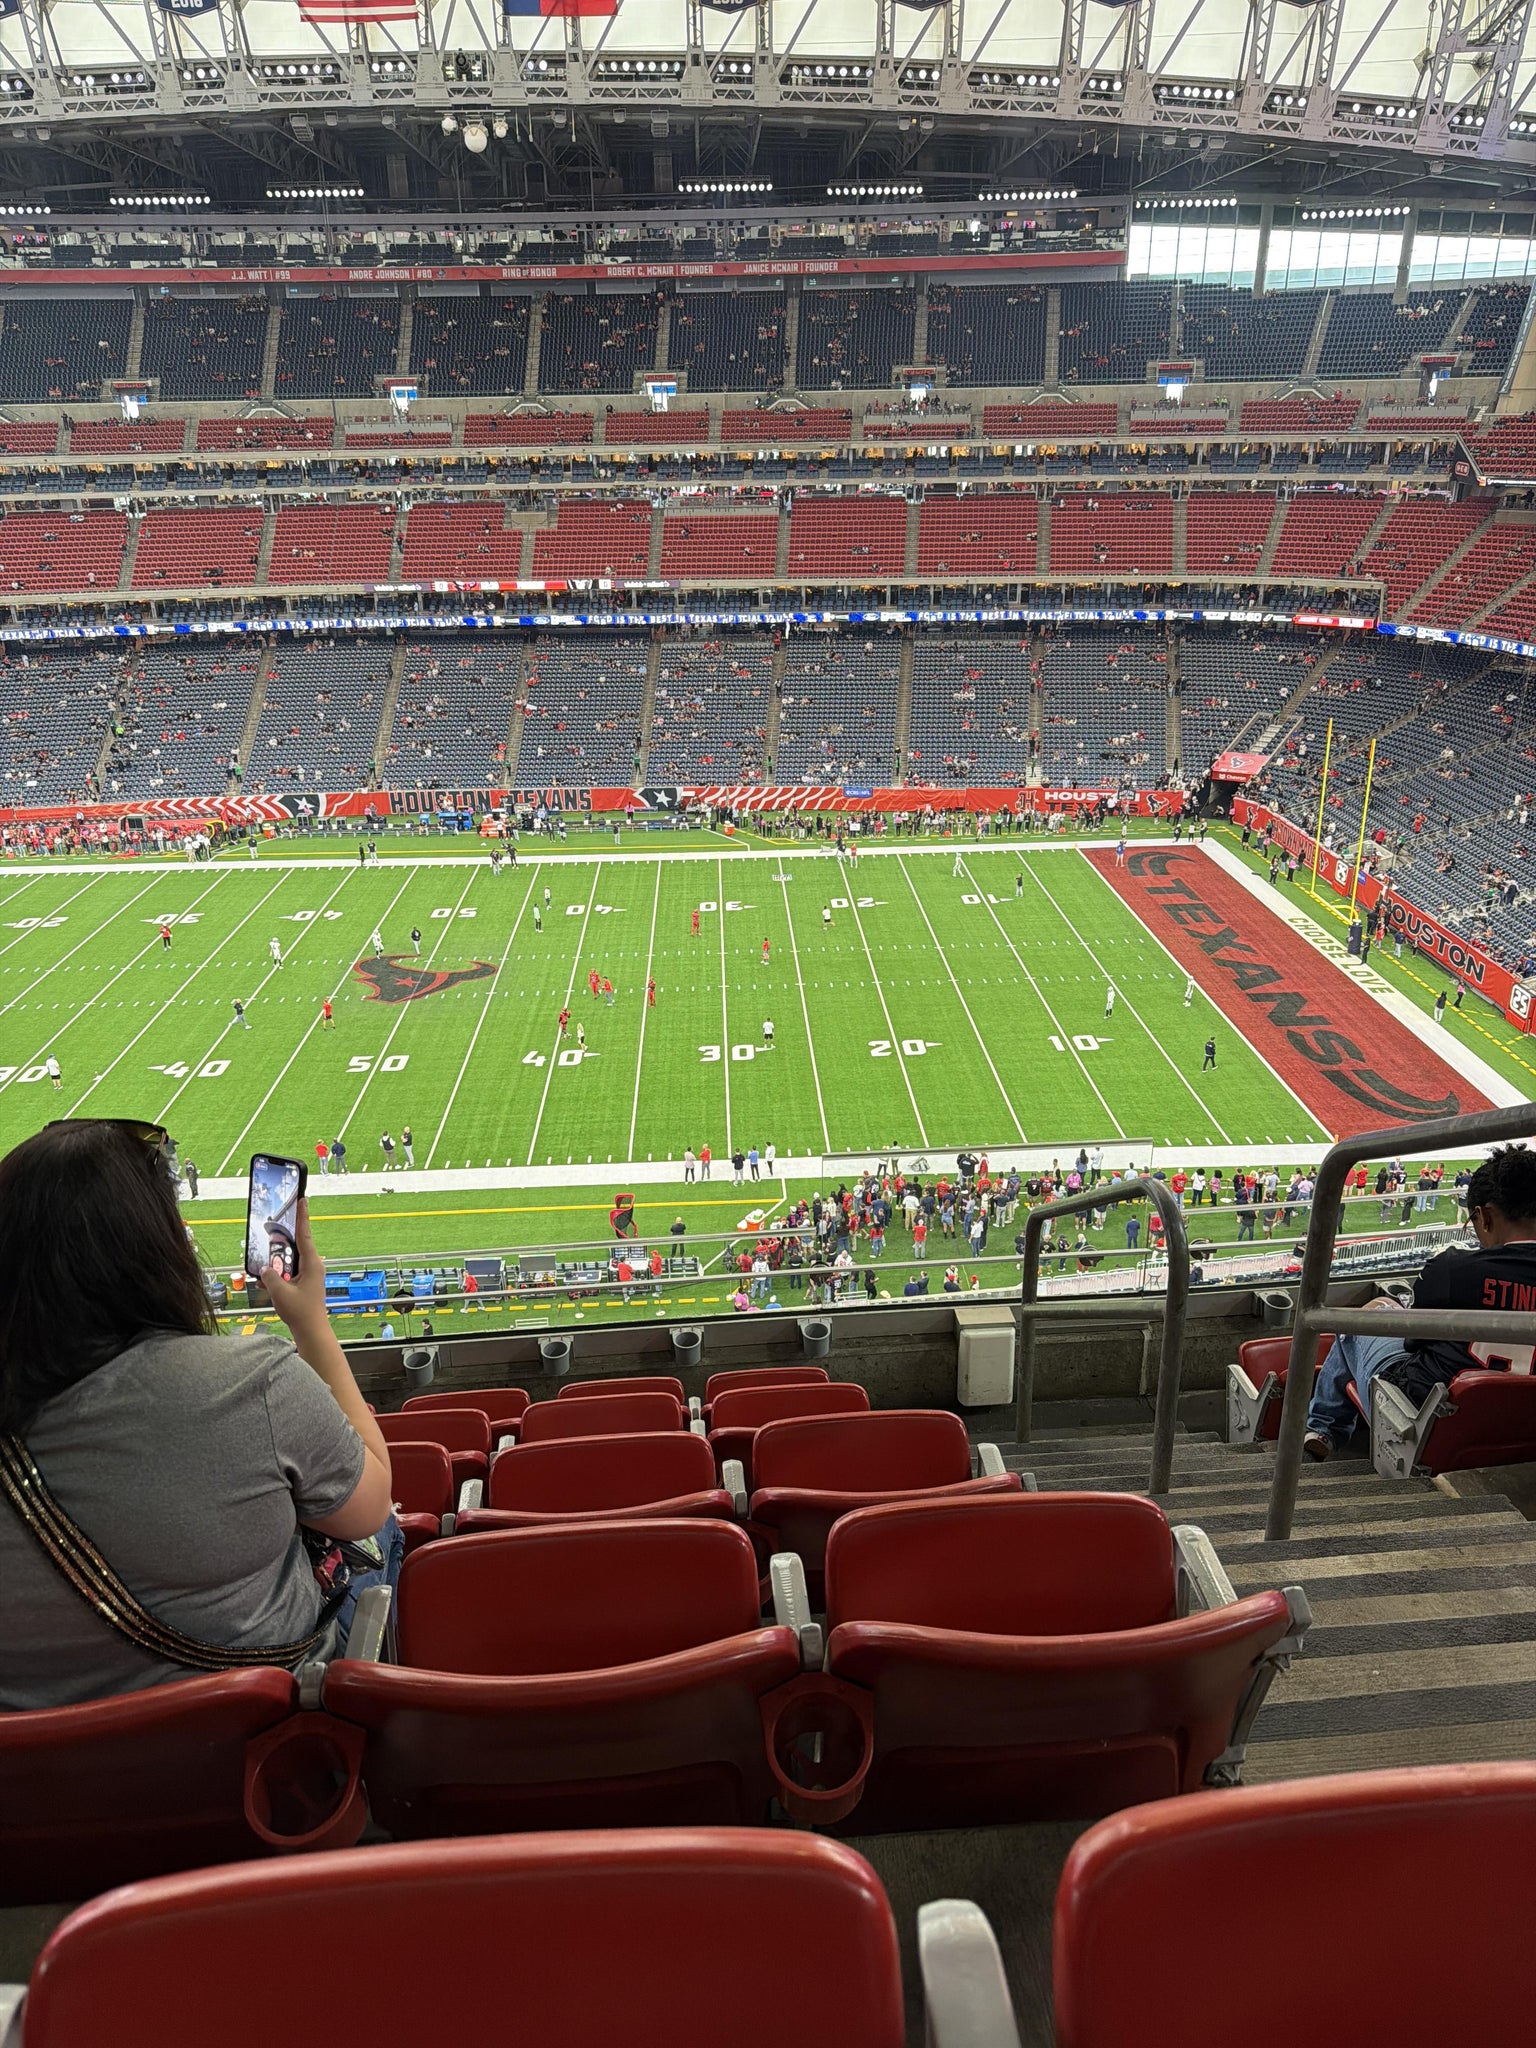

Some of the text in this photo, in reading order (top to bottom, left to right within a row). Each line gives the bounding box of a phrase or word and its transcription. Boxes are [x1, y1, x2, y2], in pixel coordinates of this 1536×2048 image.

[249, 270, 267, 280] WATT
[275, 270, 290, 279] #99
[349, 269, 432, 279] ANDRE JOHNSON #80
[502, 268, 521, 277] RING
[530, 268, 557, 277] HONOR
[607, 267, 636, 276] ROBERT
[647, 266, 674, 275] MCNAIR
[680, 265, 714, 275] FOUNDER
[744, 262, 838, 273] JANICE MCNAIR FOUNDER
[355, 617, 386, 629] TEXAS
[689, 613, 718, 624] TEXAS
[1022, 610, 1053, 621] TEXAS
[508, 789, 592, 812] TEXANS
[1288, 917, 1396, 994] CHOOSE LOVE
[1143, 877, 1367, 1067] TEXANS
[1512, 988, 1529, 1014] 25
[868, 1039, 927, 1057] 20
[1047, 1034, 1100, 1052] 10
[521, 1049, 584, 1067] 40
[698, 1044, 755, 1062] 30
[163, 1059, 232, 1078] 40
[345, 1054, 410, 1073] 50
[1482, 1277, 1536, 1312] STIN
